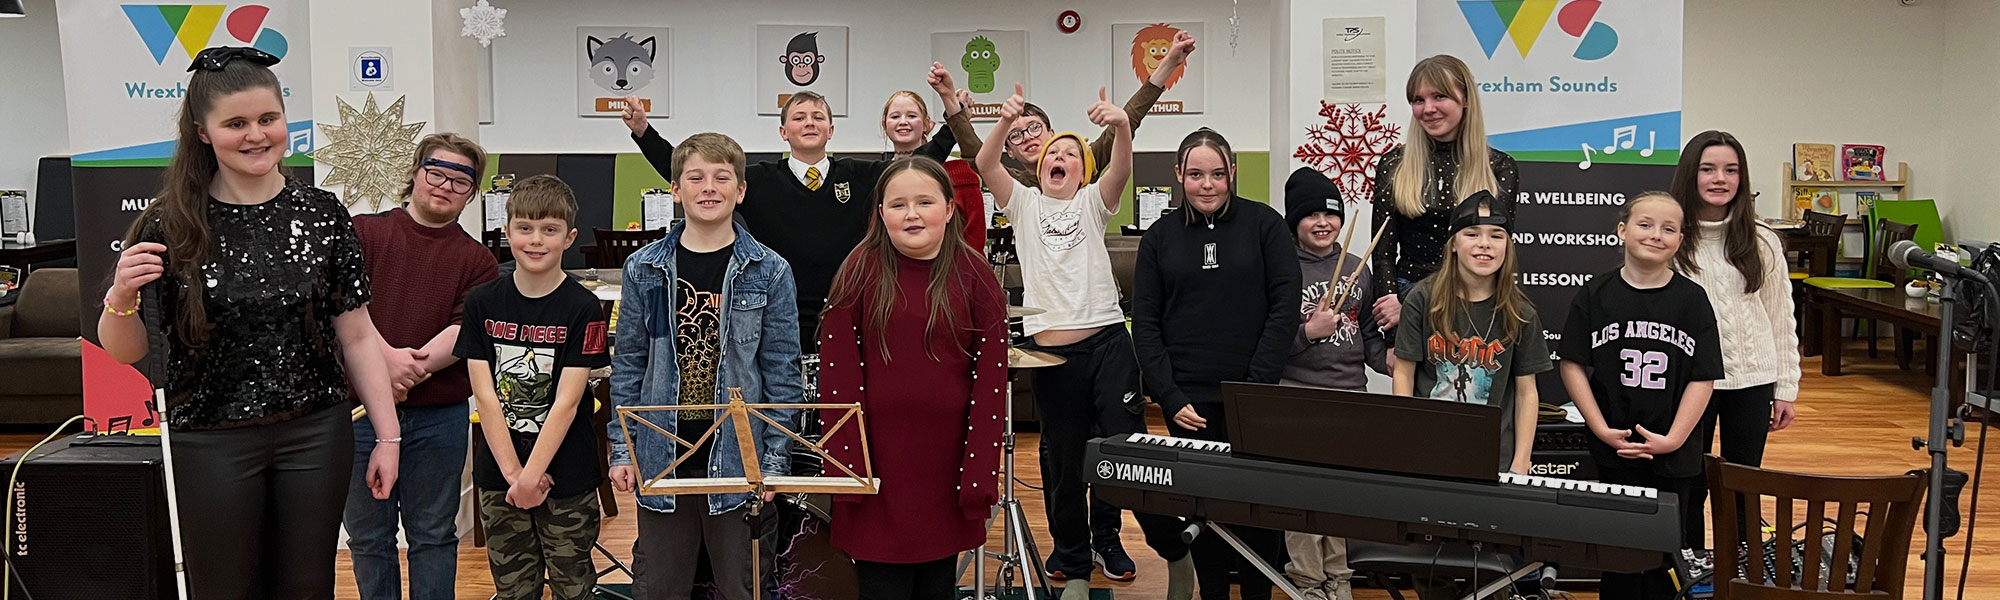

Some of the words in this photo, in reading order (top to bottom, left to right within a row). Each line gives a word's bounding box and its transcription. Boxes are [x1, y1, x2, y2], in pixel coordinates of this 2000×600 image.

[125, 82, 187, 98] Wrexh
[1477, 76, 1543, 93] rexham
[1549, 76, 1618, 93] Sounds
[971, 106, 1001, 115] ALLUM
[1149, 103, 1180, 113] THUR
[1534, 192, 1626, 206] WELLBEING
[1511, 232, 1535, 244] ND
[1538, 233, 1625, 246] WORKSHO
[485, 319, 518, 340] ONE
[520, 325, 567, 343] PIECE
[1542, 329, 1561, 340] Sou
[1591, 322, 1620, 349] LOS
[1624, 320, 1696, 357] ANGELES
[1620, 348, 1668, 389] 32
[1115, 462, 1173, 486] YAMAHA
[1529, 461, 1577, 475] kstar
[14, 481, 28, 543] electronic
[17, 544, 28, 556] tc
